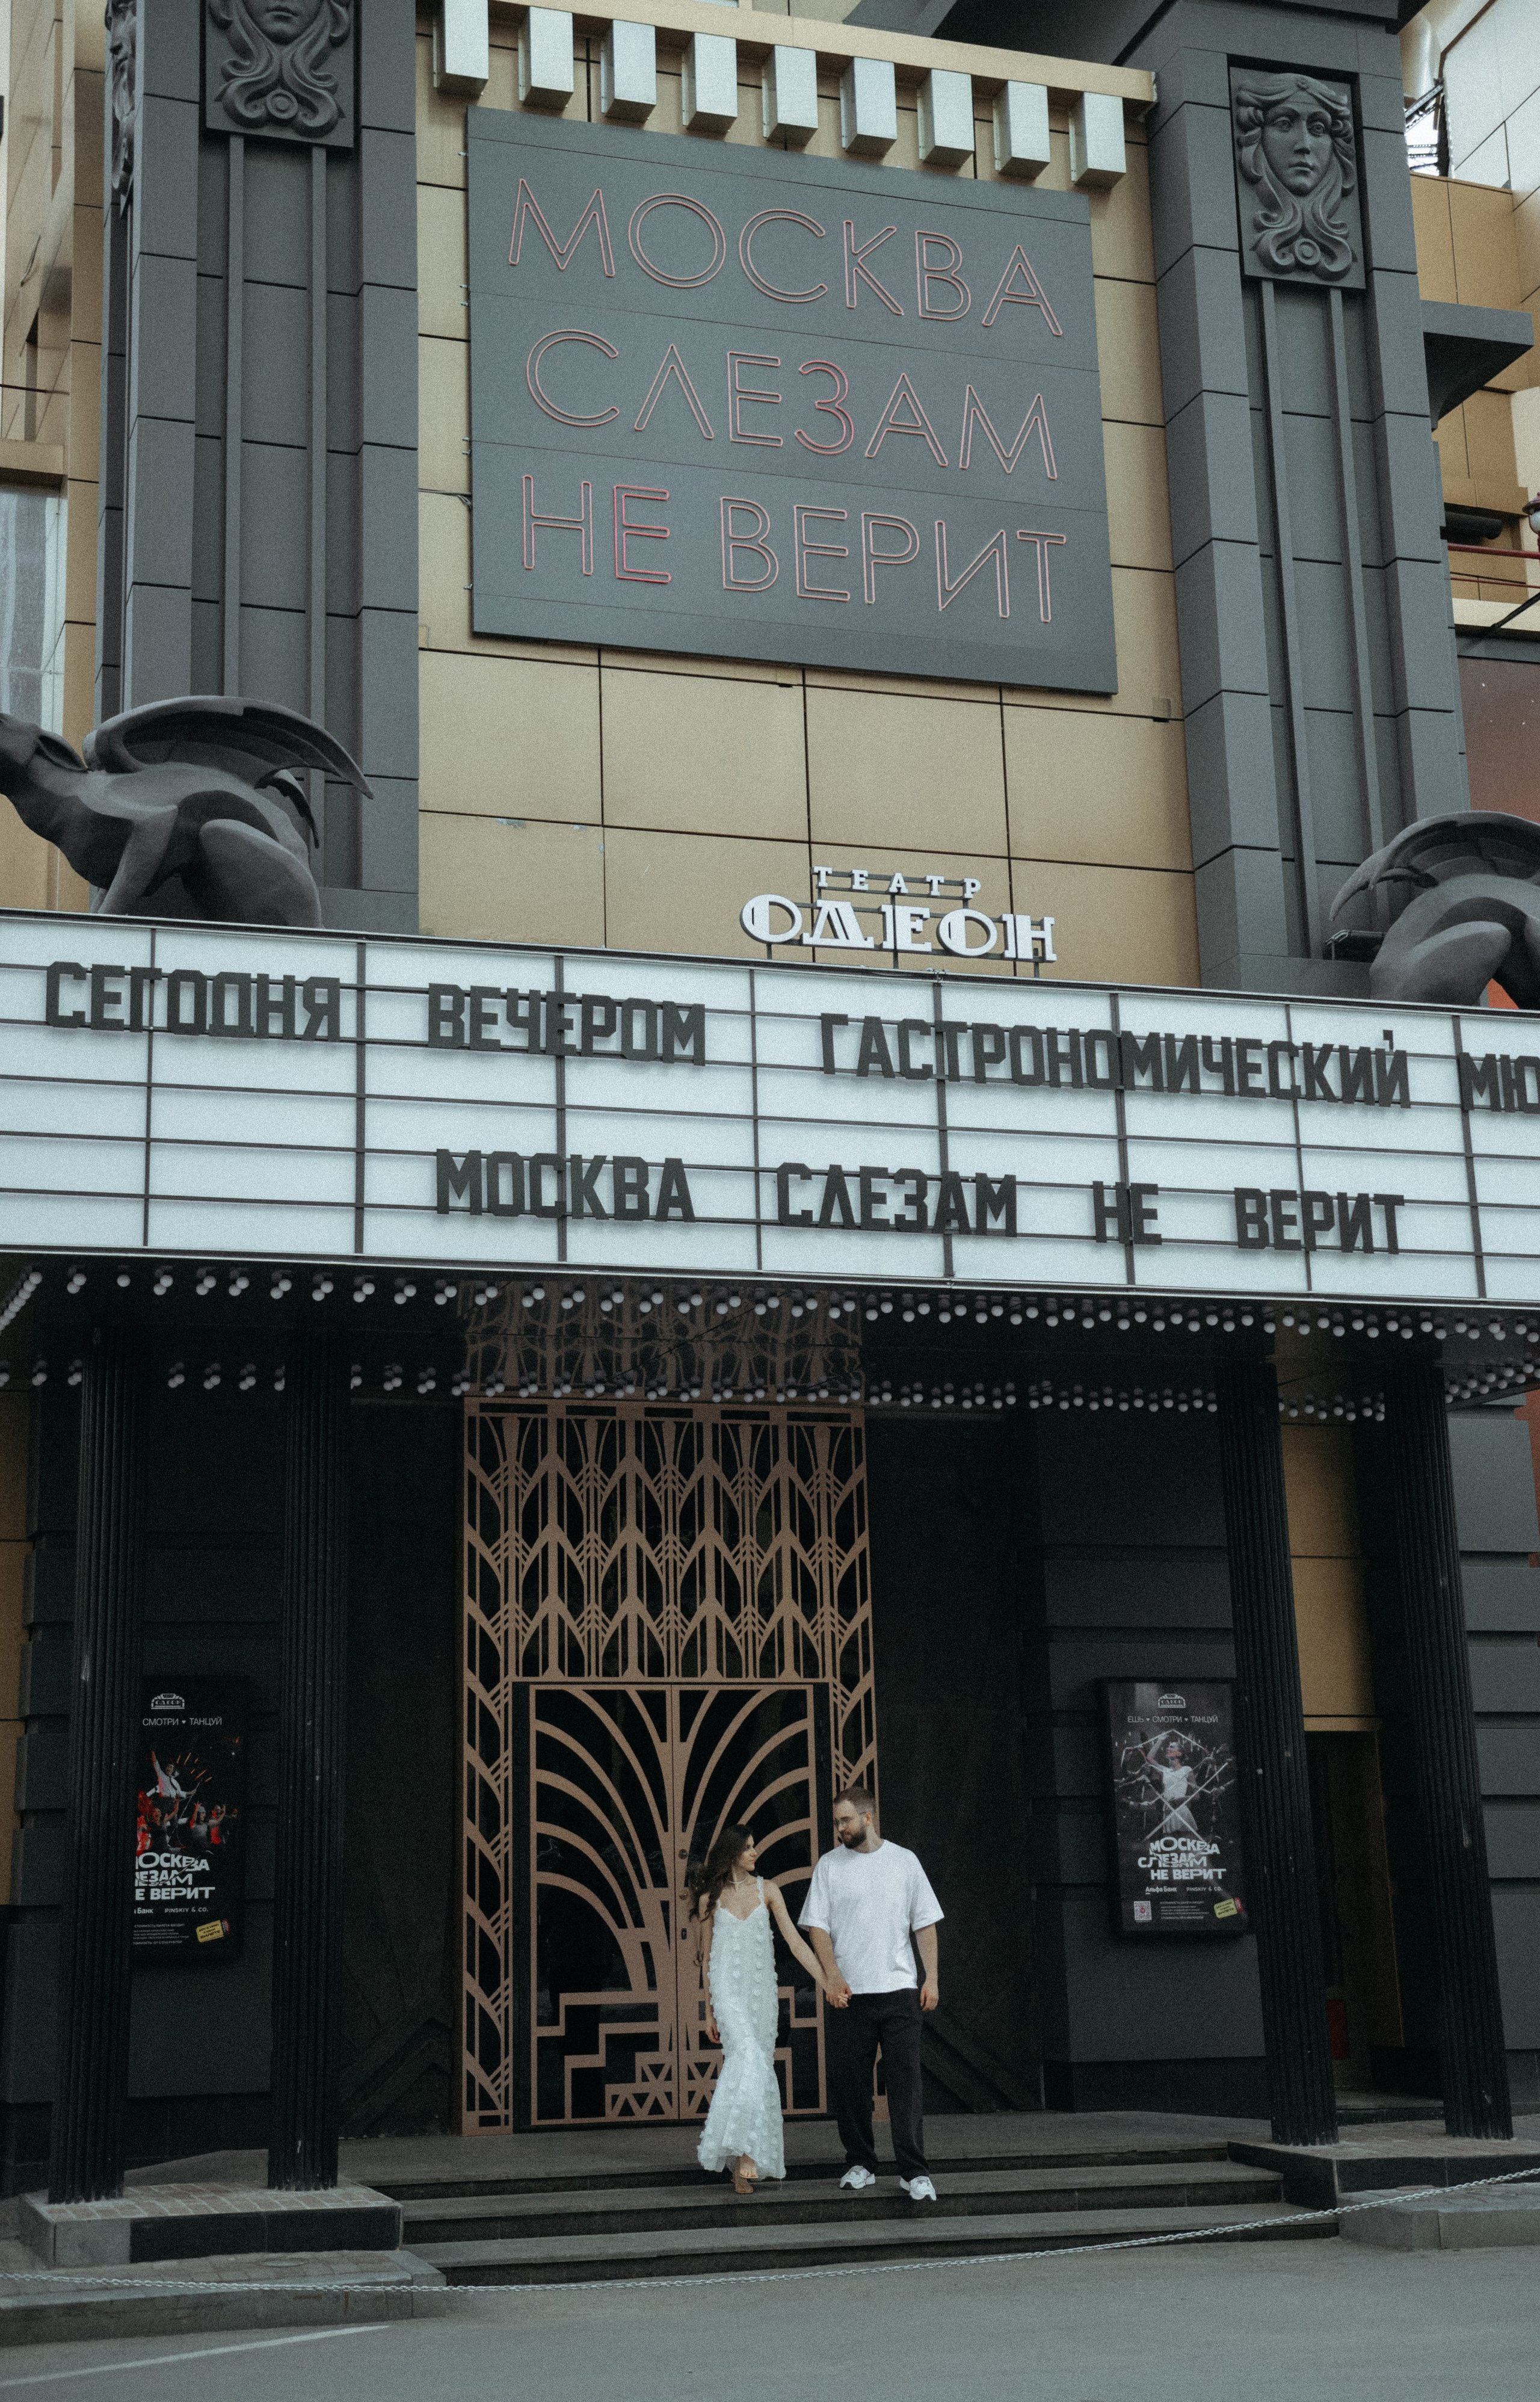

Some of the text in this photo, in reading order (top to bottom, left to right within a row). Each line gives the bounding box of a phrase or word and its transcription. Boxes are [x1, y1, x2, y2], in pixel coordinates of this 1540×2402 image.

[508, 179, 1062, 335] МОСКВА
[526, 329, 1058, 480] СЛЕЗАМ
[522, 475, 1066, 622] НЕ ВЕРИТ
[811, 866, 981, 899] ТЕАТР
[740, 894, 1058, 962] ОДЕОН
[46, 961, 341, 1042] СЕГОДНЯ
[428, 982, 706, 1066] ВЕЧЕРОМ
[821, 1013, 1411, 1109] ГАСТРОНОМИЧЕСКИЙ
[436, 1148, 1405, 1255] МОСКВА СЛЕЗАМ НЕ ВЕРИТ
[142, 1716, 222, 1726] СМОТРИ ТАНЦУЙ
[1190, 1714, 1218, 1724] ТАНЦУЙ
[1149, 1836, 1221, 1855] МОСКВА
[135, 1851, 211, 1871] ОСКВА
[1138, 1853, 1207, 1868] СЛЕЗАМ
[134, 1869, 193, 1887] ЕЗАМ
[1150, 1868, 1227, 1880] НЕ ВЕРИТ
[135, 1886, 216, 1901] Е ВЕРИТ
